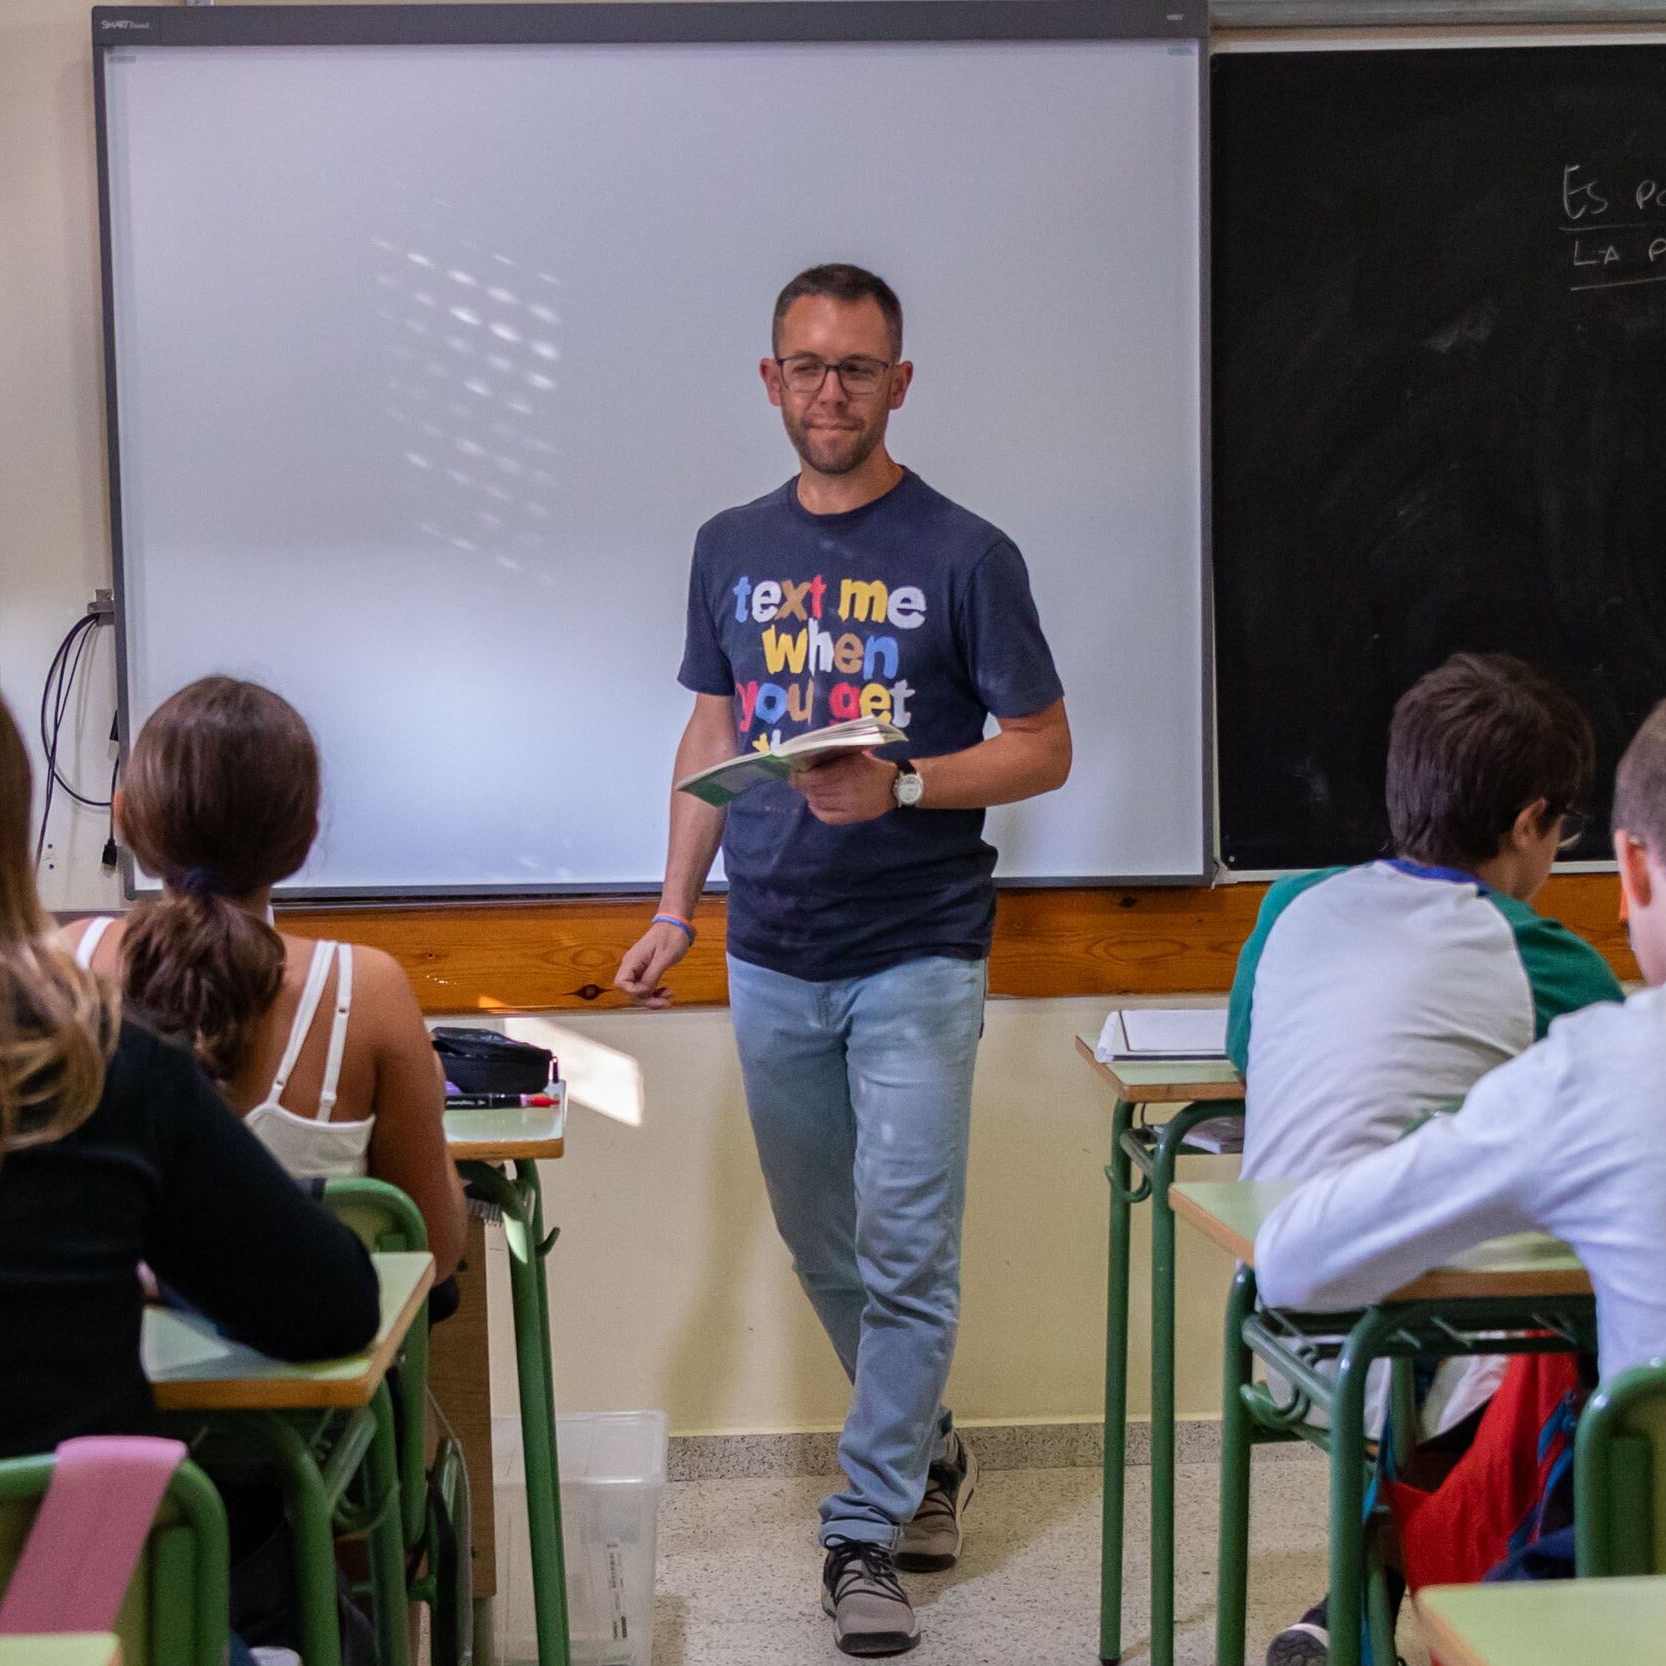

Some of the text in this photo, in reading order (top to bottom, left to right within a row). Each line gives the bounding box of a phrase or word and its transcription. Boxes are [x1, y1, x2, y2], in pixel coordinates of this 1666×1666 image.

[1574, 240, 1620, 266] LA
[733, 574, 927, 629] text me
[762, 617, 899, 680] when
[736, 678, 814, 732] you
